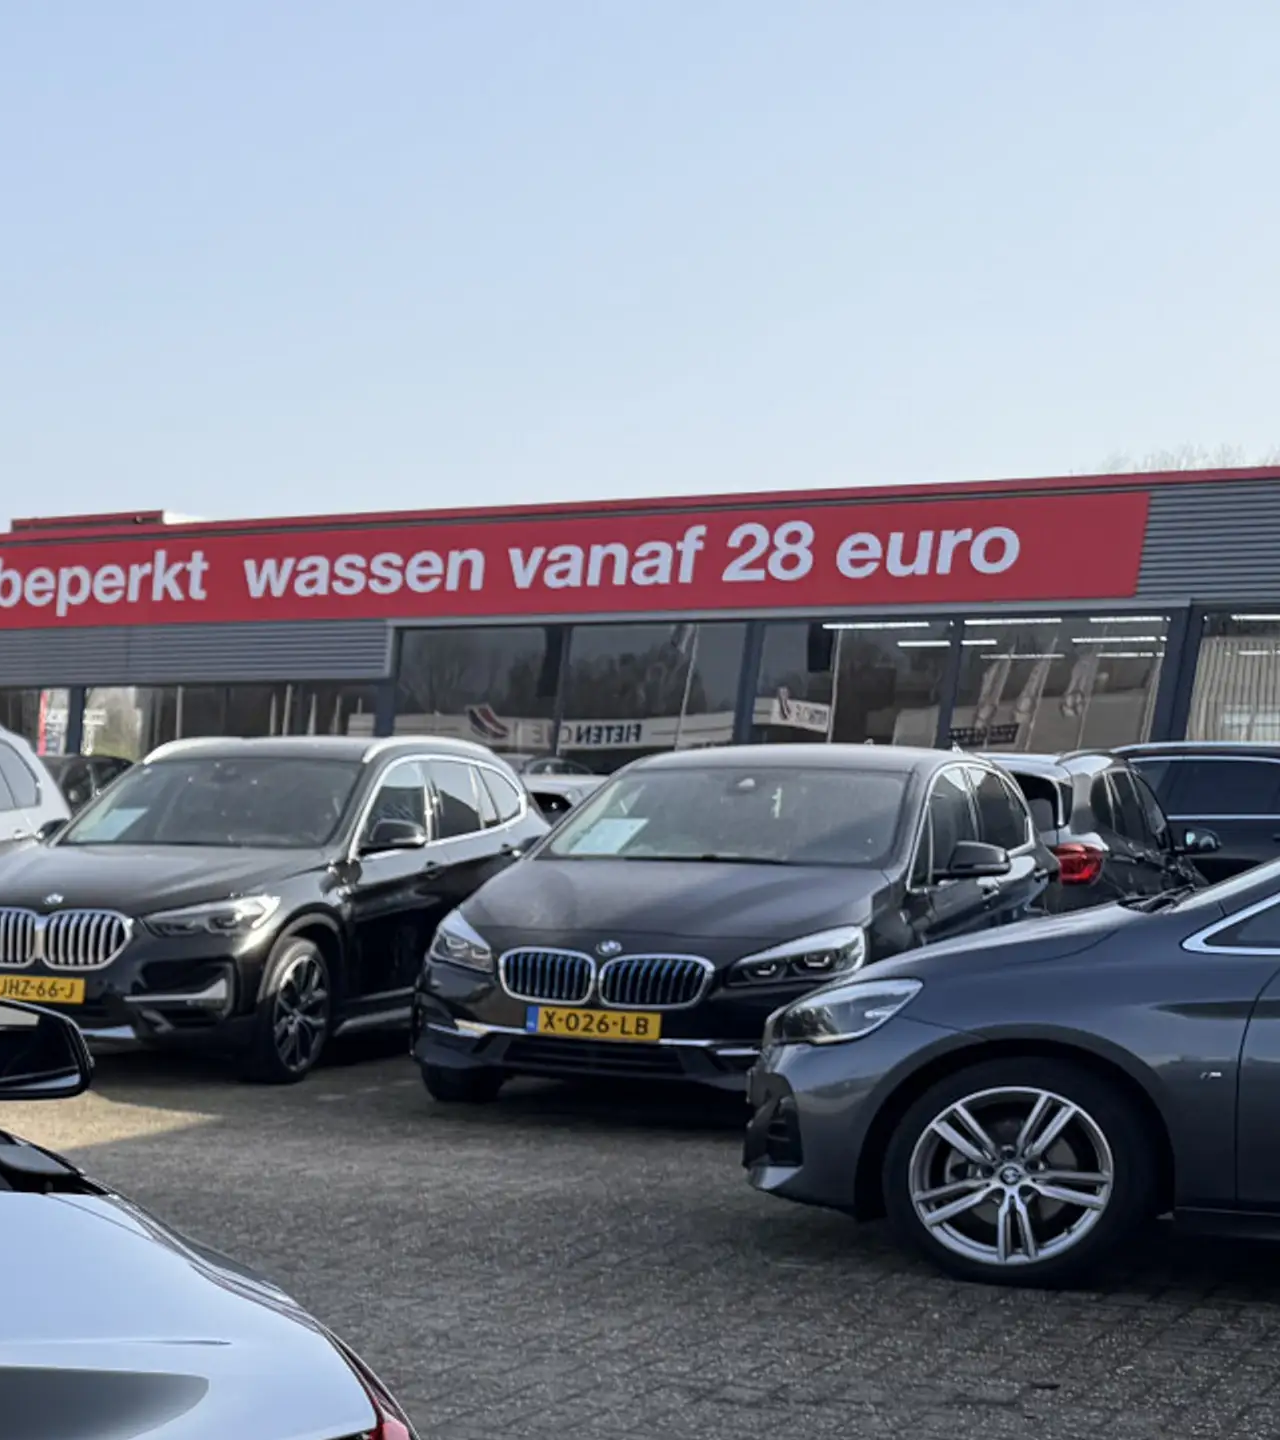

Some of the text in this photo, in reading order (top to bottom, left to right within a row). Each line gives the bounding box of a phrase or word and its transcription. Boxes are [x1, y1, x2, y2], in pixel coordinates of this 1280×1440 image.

[243, 548, 486, 598] wassen
[508, 525, 707, 589] vanaf
[722, 520, 815, 582] 28
[835, 526, 1021, 580] euro
[544, 1011, 649, 1035] X-026-LB
